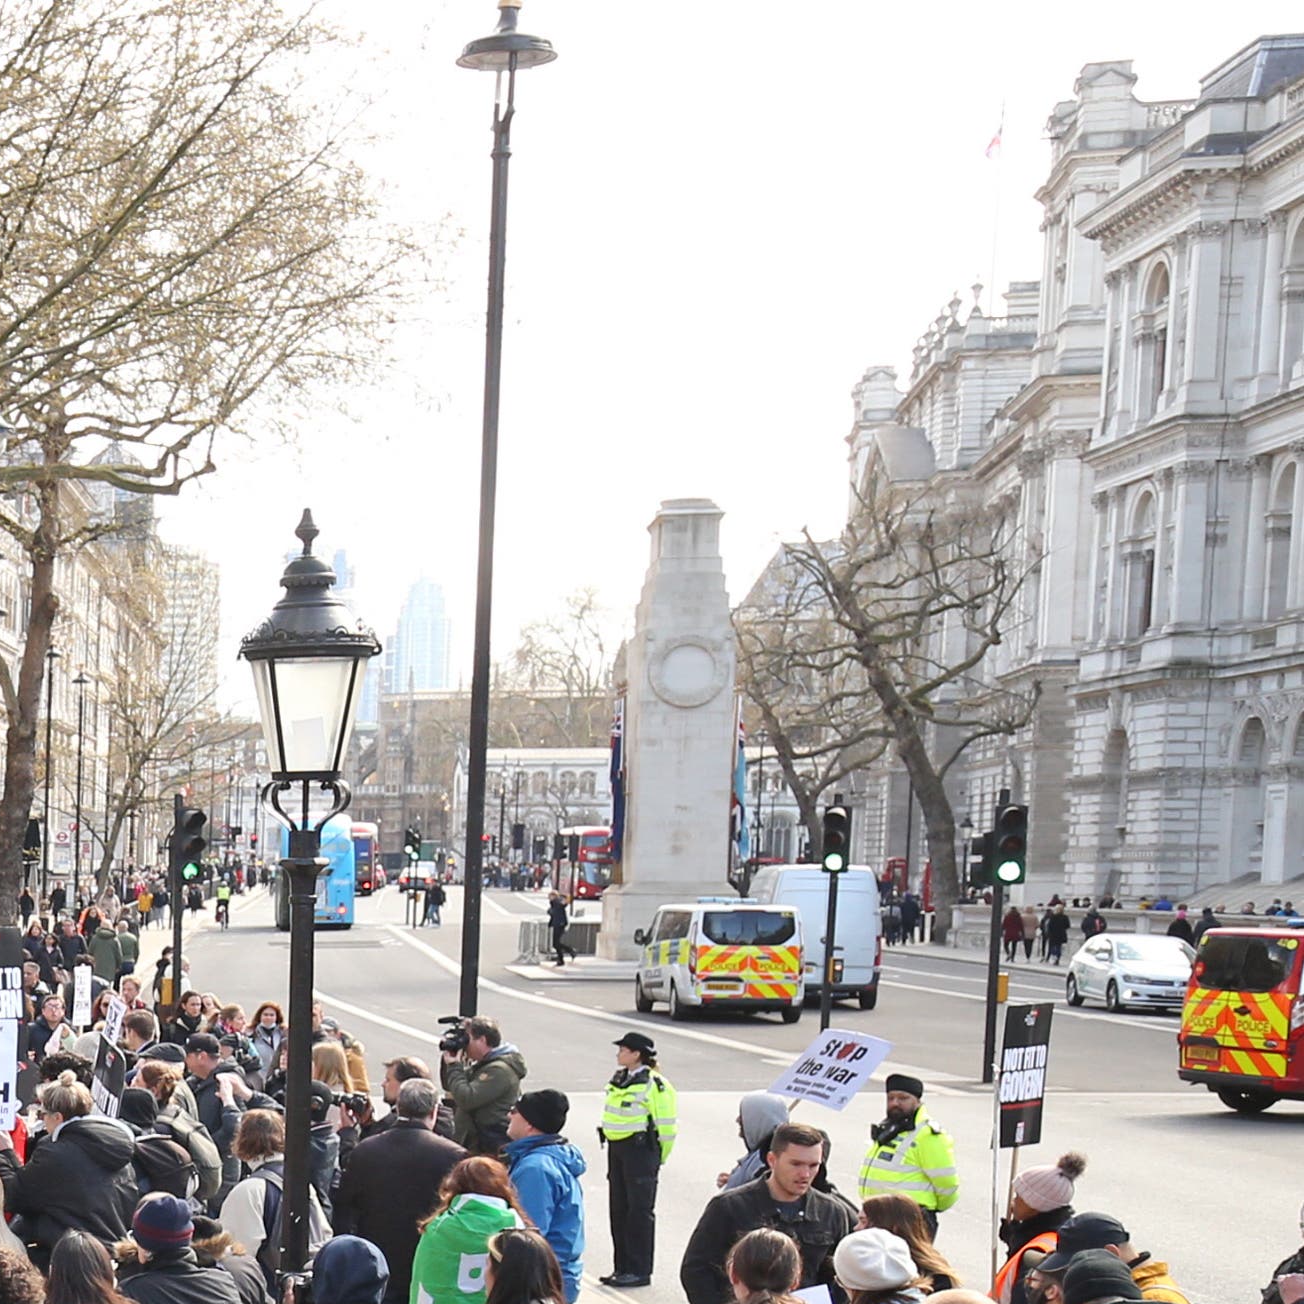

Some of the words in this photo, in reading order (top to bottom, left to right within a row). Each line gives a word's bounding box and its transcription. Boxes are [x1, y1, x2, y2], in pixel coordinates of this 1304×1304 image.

[3, 967, 22, 988] TO
[1238, 1021, 1270, 1032] POLICE
[1003, 1048, 1023, 1071] NOT
[1024, 1046, 1036, 1069] FIT
[1036, 1045, 1047, 1067] TO
[796, 1058, 823, 1076] the
[823, 1066, 858, 1085] war
[1000, 1068, 1044, 1102] GOVERN
